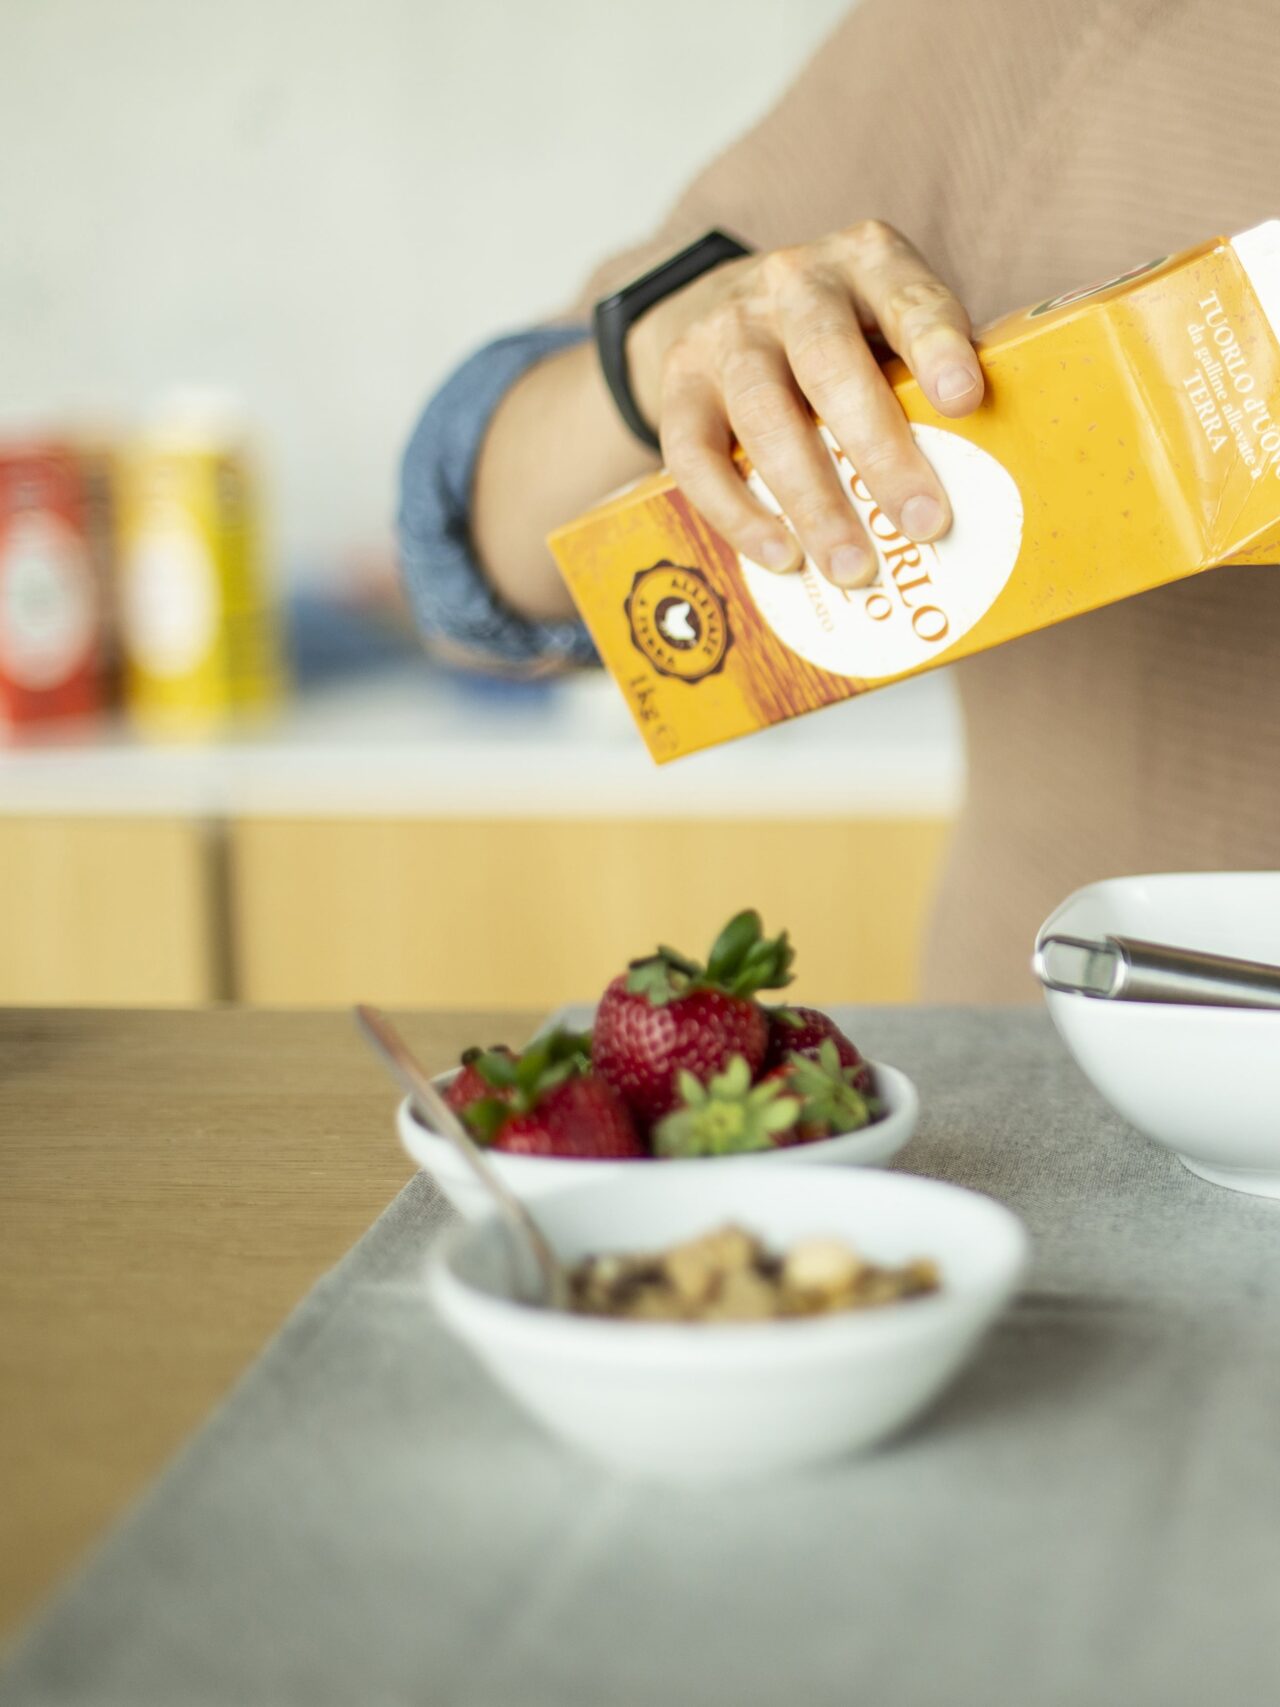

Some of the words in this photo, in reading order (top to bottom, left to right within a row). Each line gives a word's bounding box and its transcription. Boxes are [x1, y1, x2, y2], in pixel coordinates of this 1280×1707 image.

[1187, 322, 1202, 345] da
[1195, 346, 1228, 401] galline
[1221, 402, 1258, 466] allevate
[1250, 466, 1264, 481] a
[1198, 290, 1254, 394] TUORLO
[1182, 368, 1229, 454] TERRA
[833, 449, 949, 642] ORLO
